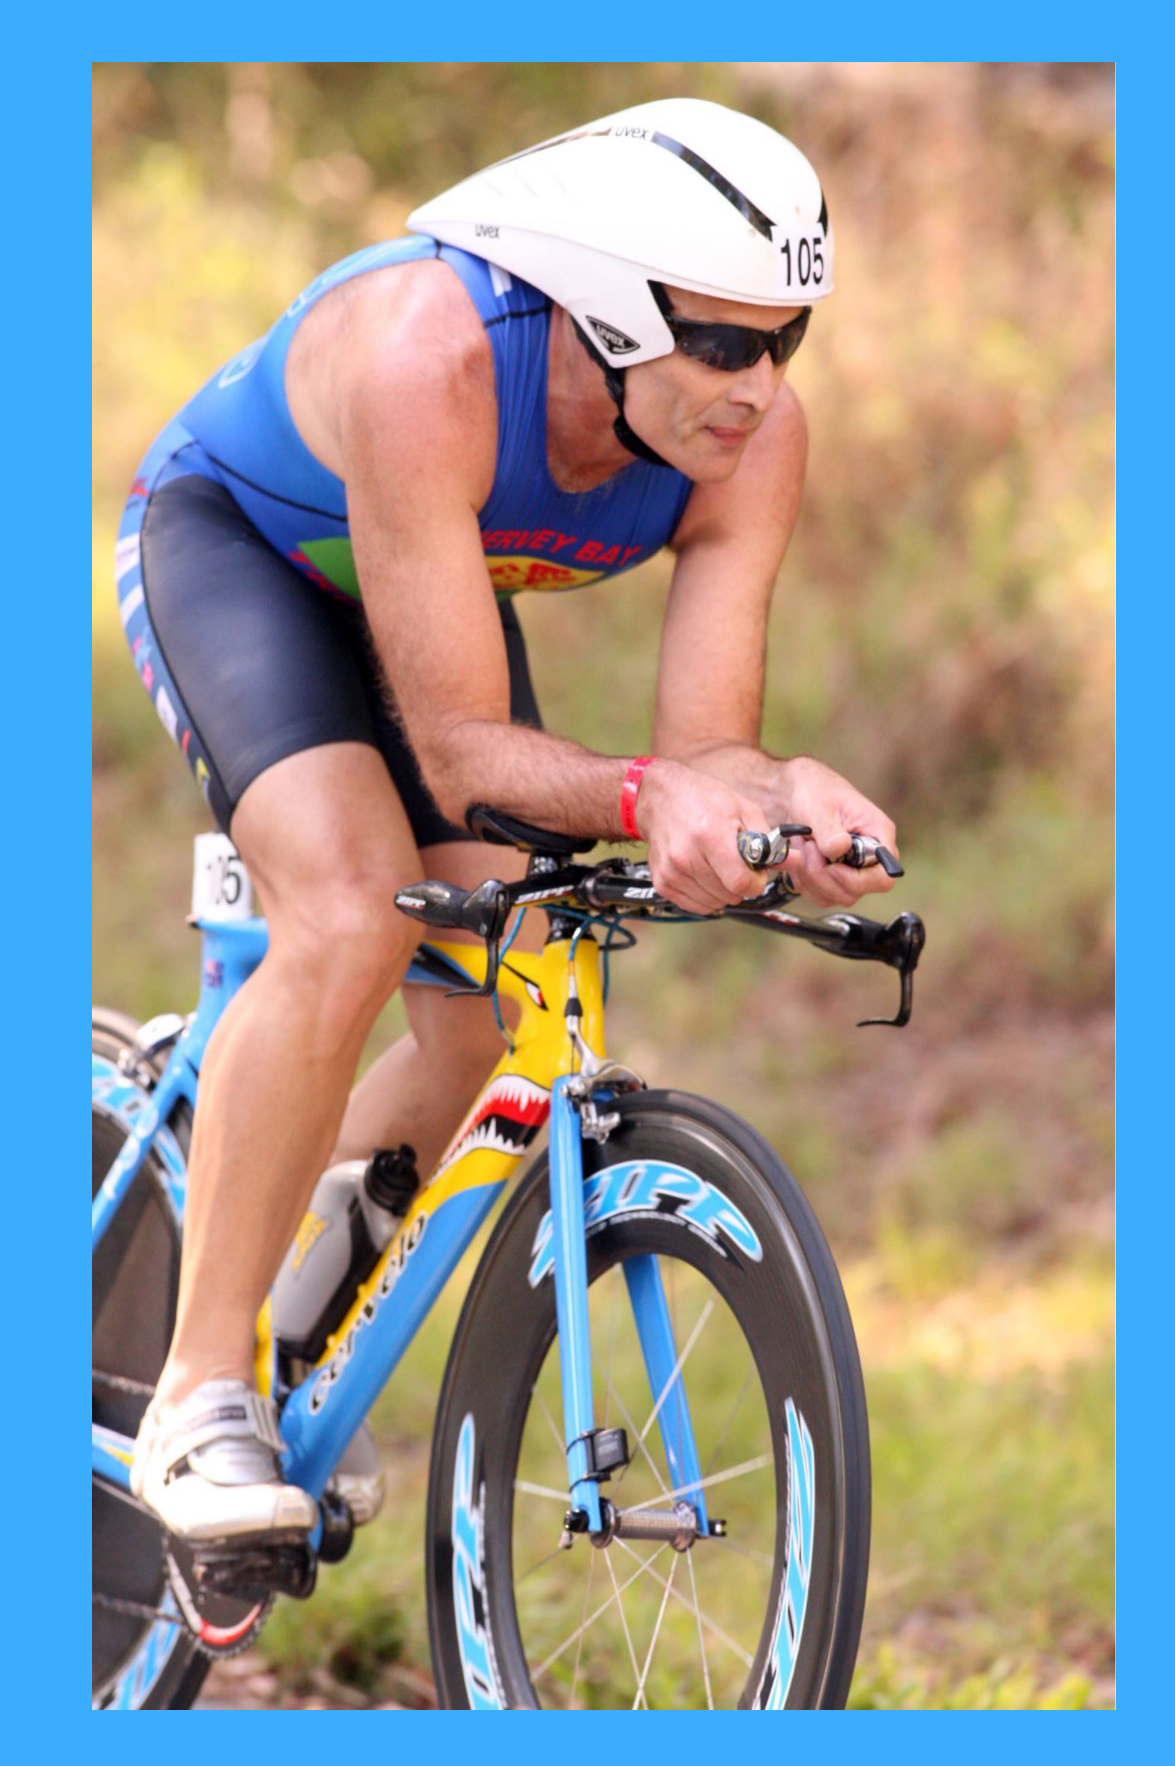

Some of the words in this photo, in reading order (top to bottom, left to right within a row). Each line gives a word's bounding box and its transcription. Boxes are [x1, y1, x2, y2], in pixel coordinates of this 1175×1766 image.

[781, 237, 825, 286] 105
[574, 540, 643, 567] BAY
[514, 884, 575, 905] ZIPP
